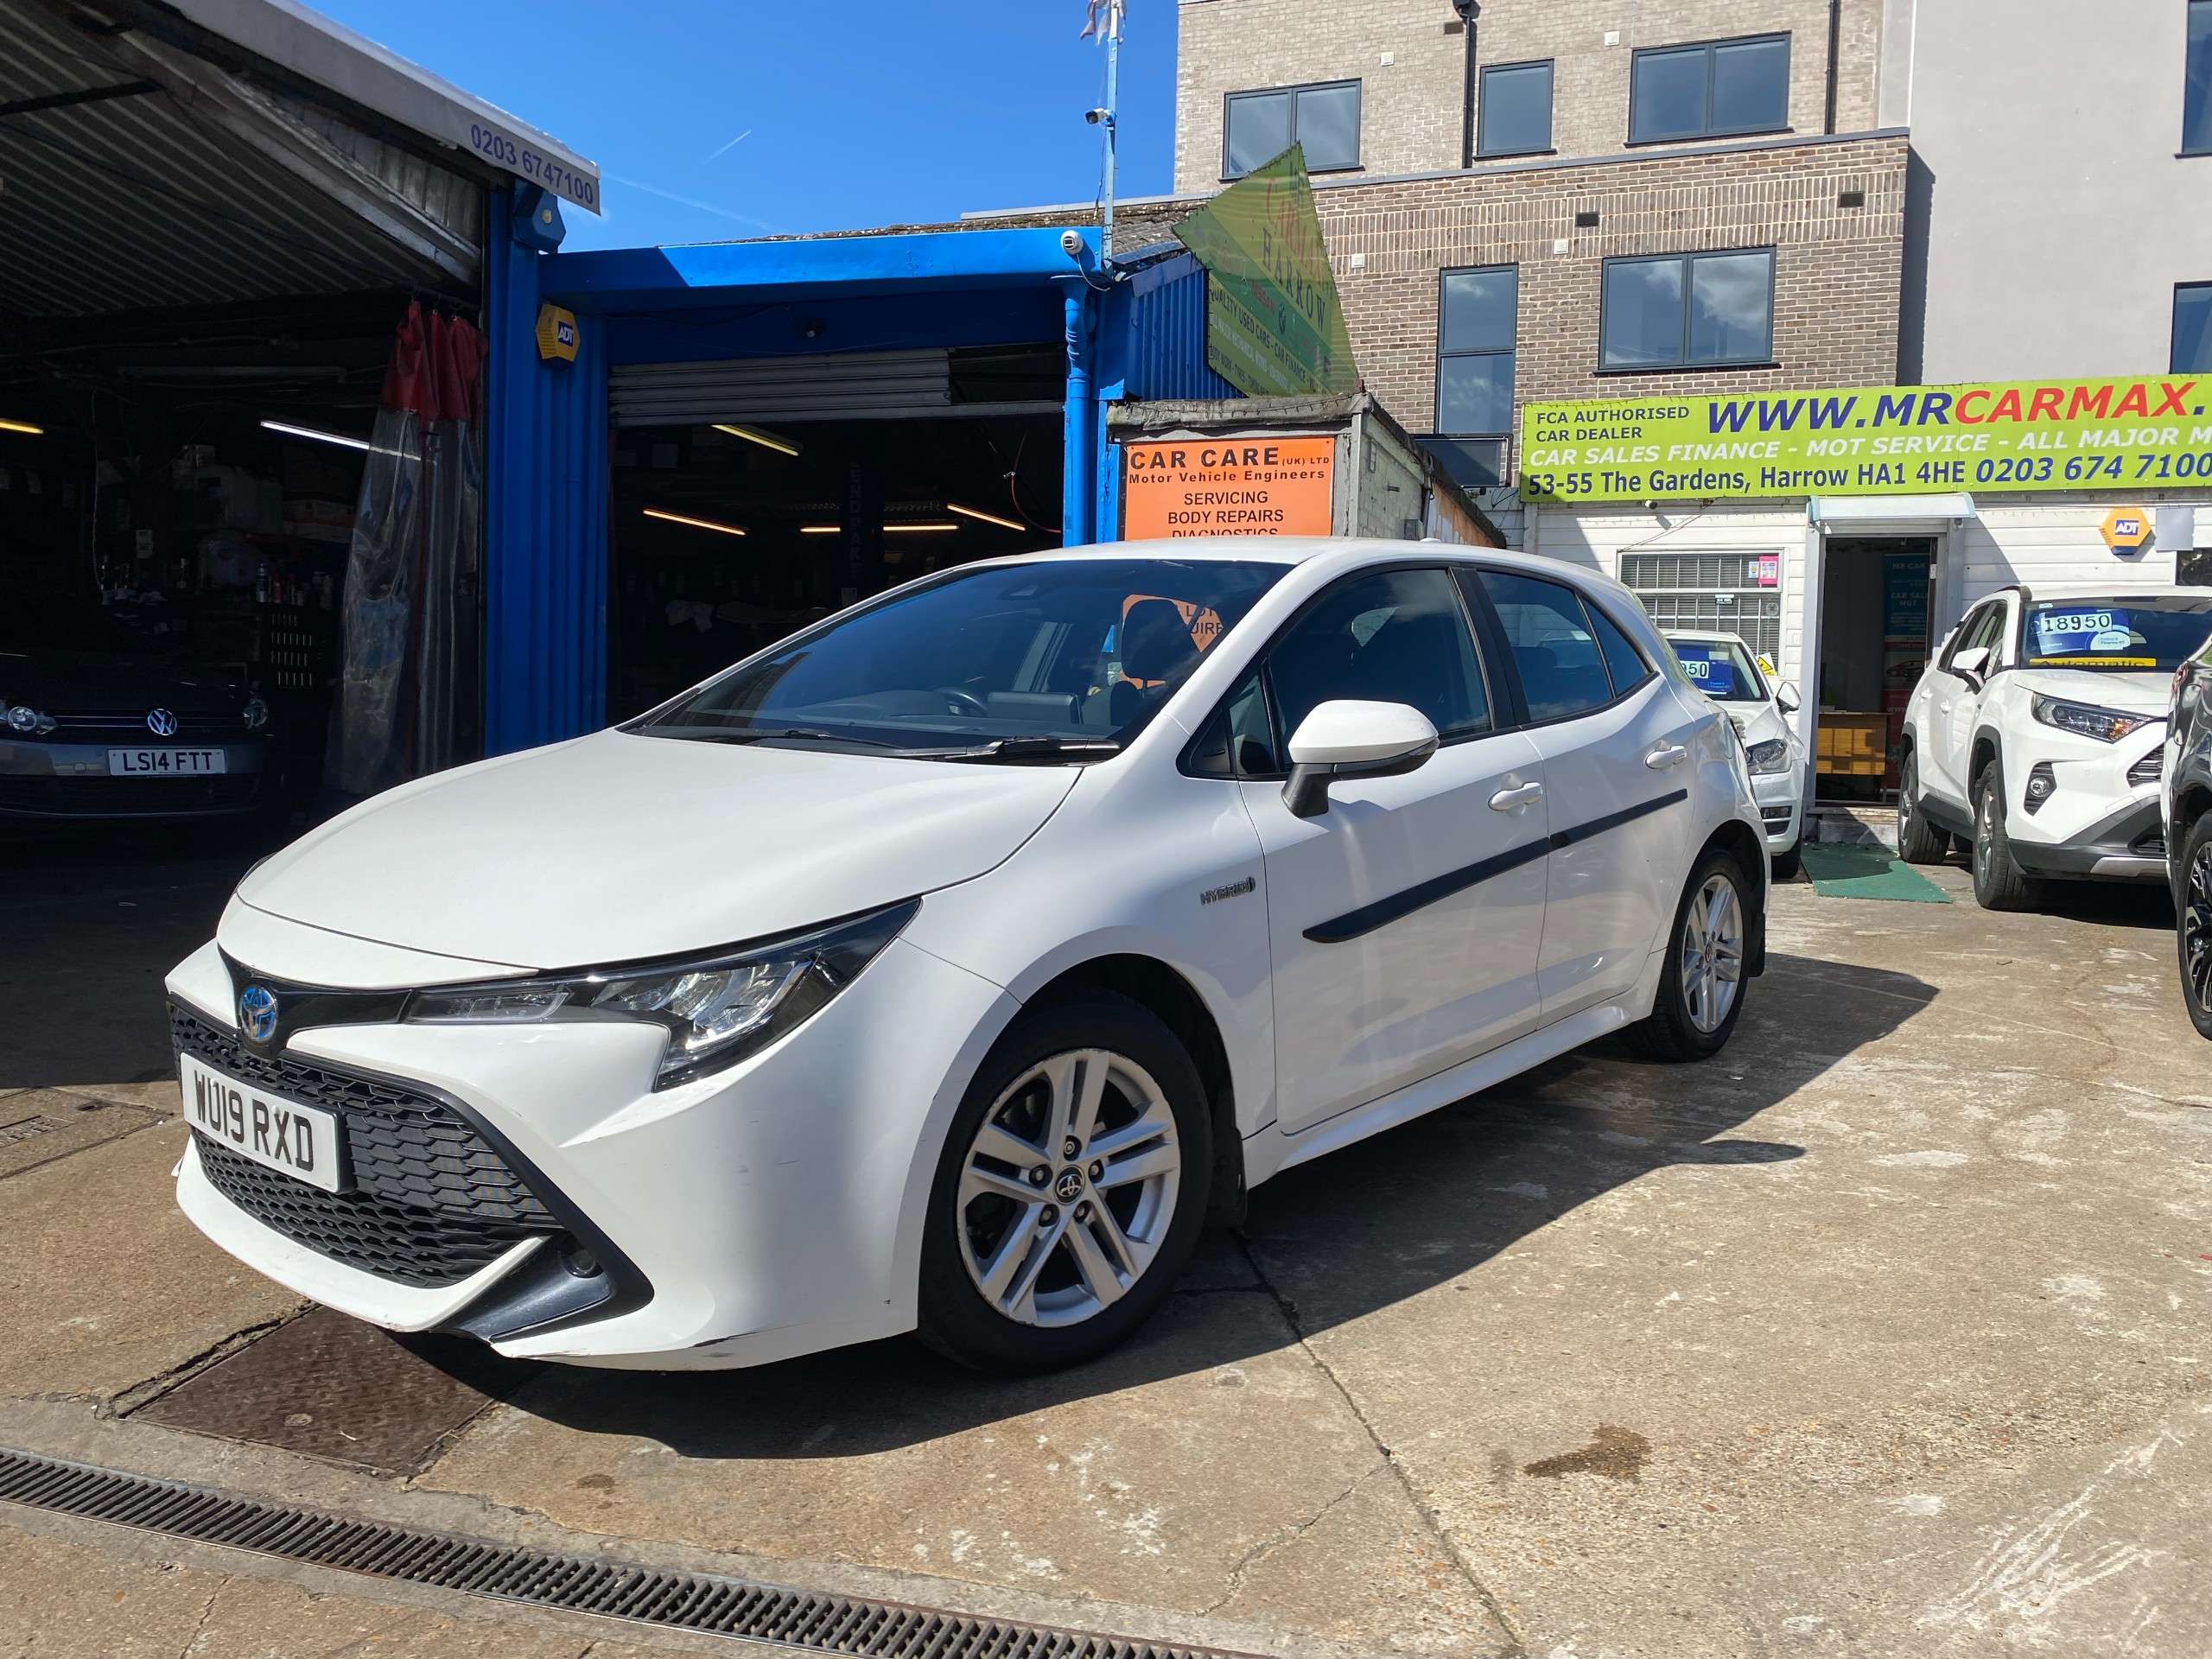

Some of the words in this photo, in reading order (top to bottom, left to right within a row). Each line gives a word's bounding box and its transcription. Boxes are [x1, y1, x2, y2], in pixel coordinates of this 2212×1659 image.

[471, 124, 518, 166] 0203
[522, 149, 594, 204] 6747100
[1262, 227, 1326, 333] HARROW
[558, 325, 574, 342] ADT
[1238, 307, 1255, 334] USED
[1255, 325, 1270, 349] CARS
[1536, 411, 1568, 424] FCA
[1573, 406, 1690, 423] AUTHORISED
[1535, 429, 1571, 442] CAR
[1576, 427, 1643, 441] DEALER
[1529, 448, 1578, 467] CAR
[1584, 445, 1660, 465] SALES
[1667, 441, 1781, 461] FINANCE
[1806, 437, 1867, 457] MOT
[1871, 433, 1991, 455] SERVICE
[2017, 430, 2069, 451] ALL
[2078, 428, 2179, 448] MAJOR
[1130, 450, 1186, 469] CAR
[1200, 447, 1279, 467] CARE
[1281, 456, 1306, 466] (UK)
[1310, 456, 1330, 465] LTD
[1128, 474, 1172, 484] Motor
[1179, 471, 1236, 482] Vehicle
[1243, 469, 1325, 483] Engineers
[1529, 472, 1593, 496] 53-55
[1601, 471, 1642, 493] The
[1649, 467, 1751, 494] Gardens,
[1759, 467, 1849, 488] Harrow
[1858, 462, 1906, 486] HA1
[1916, 461, 1966, 483] 4HE
[1975, 457, 2054, 483] 0203
[2063, 455, 2122, 480] 674
[2134, 453, 2212, 479] 7100
[1184, 490, 1268, 505] SERVICING
[1167, 511, 1211, 524] BODY
[1216, 509, 1284, 523] REPAIRS
[2115, 520, 2139, 534] ADT
[2044, 614, 2111, 632] 18950
[123, 752, 170, 771] LS14
[175, 752, 213, 770] FTT
[1199, 876, 1256, 906] HYBRID
[194, 1070, 245, 1144] WU19
[251, 1098, 314, 1172] RXD
